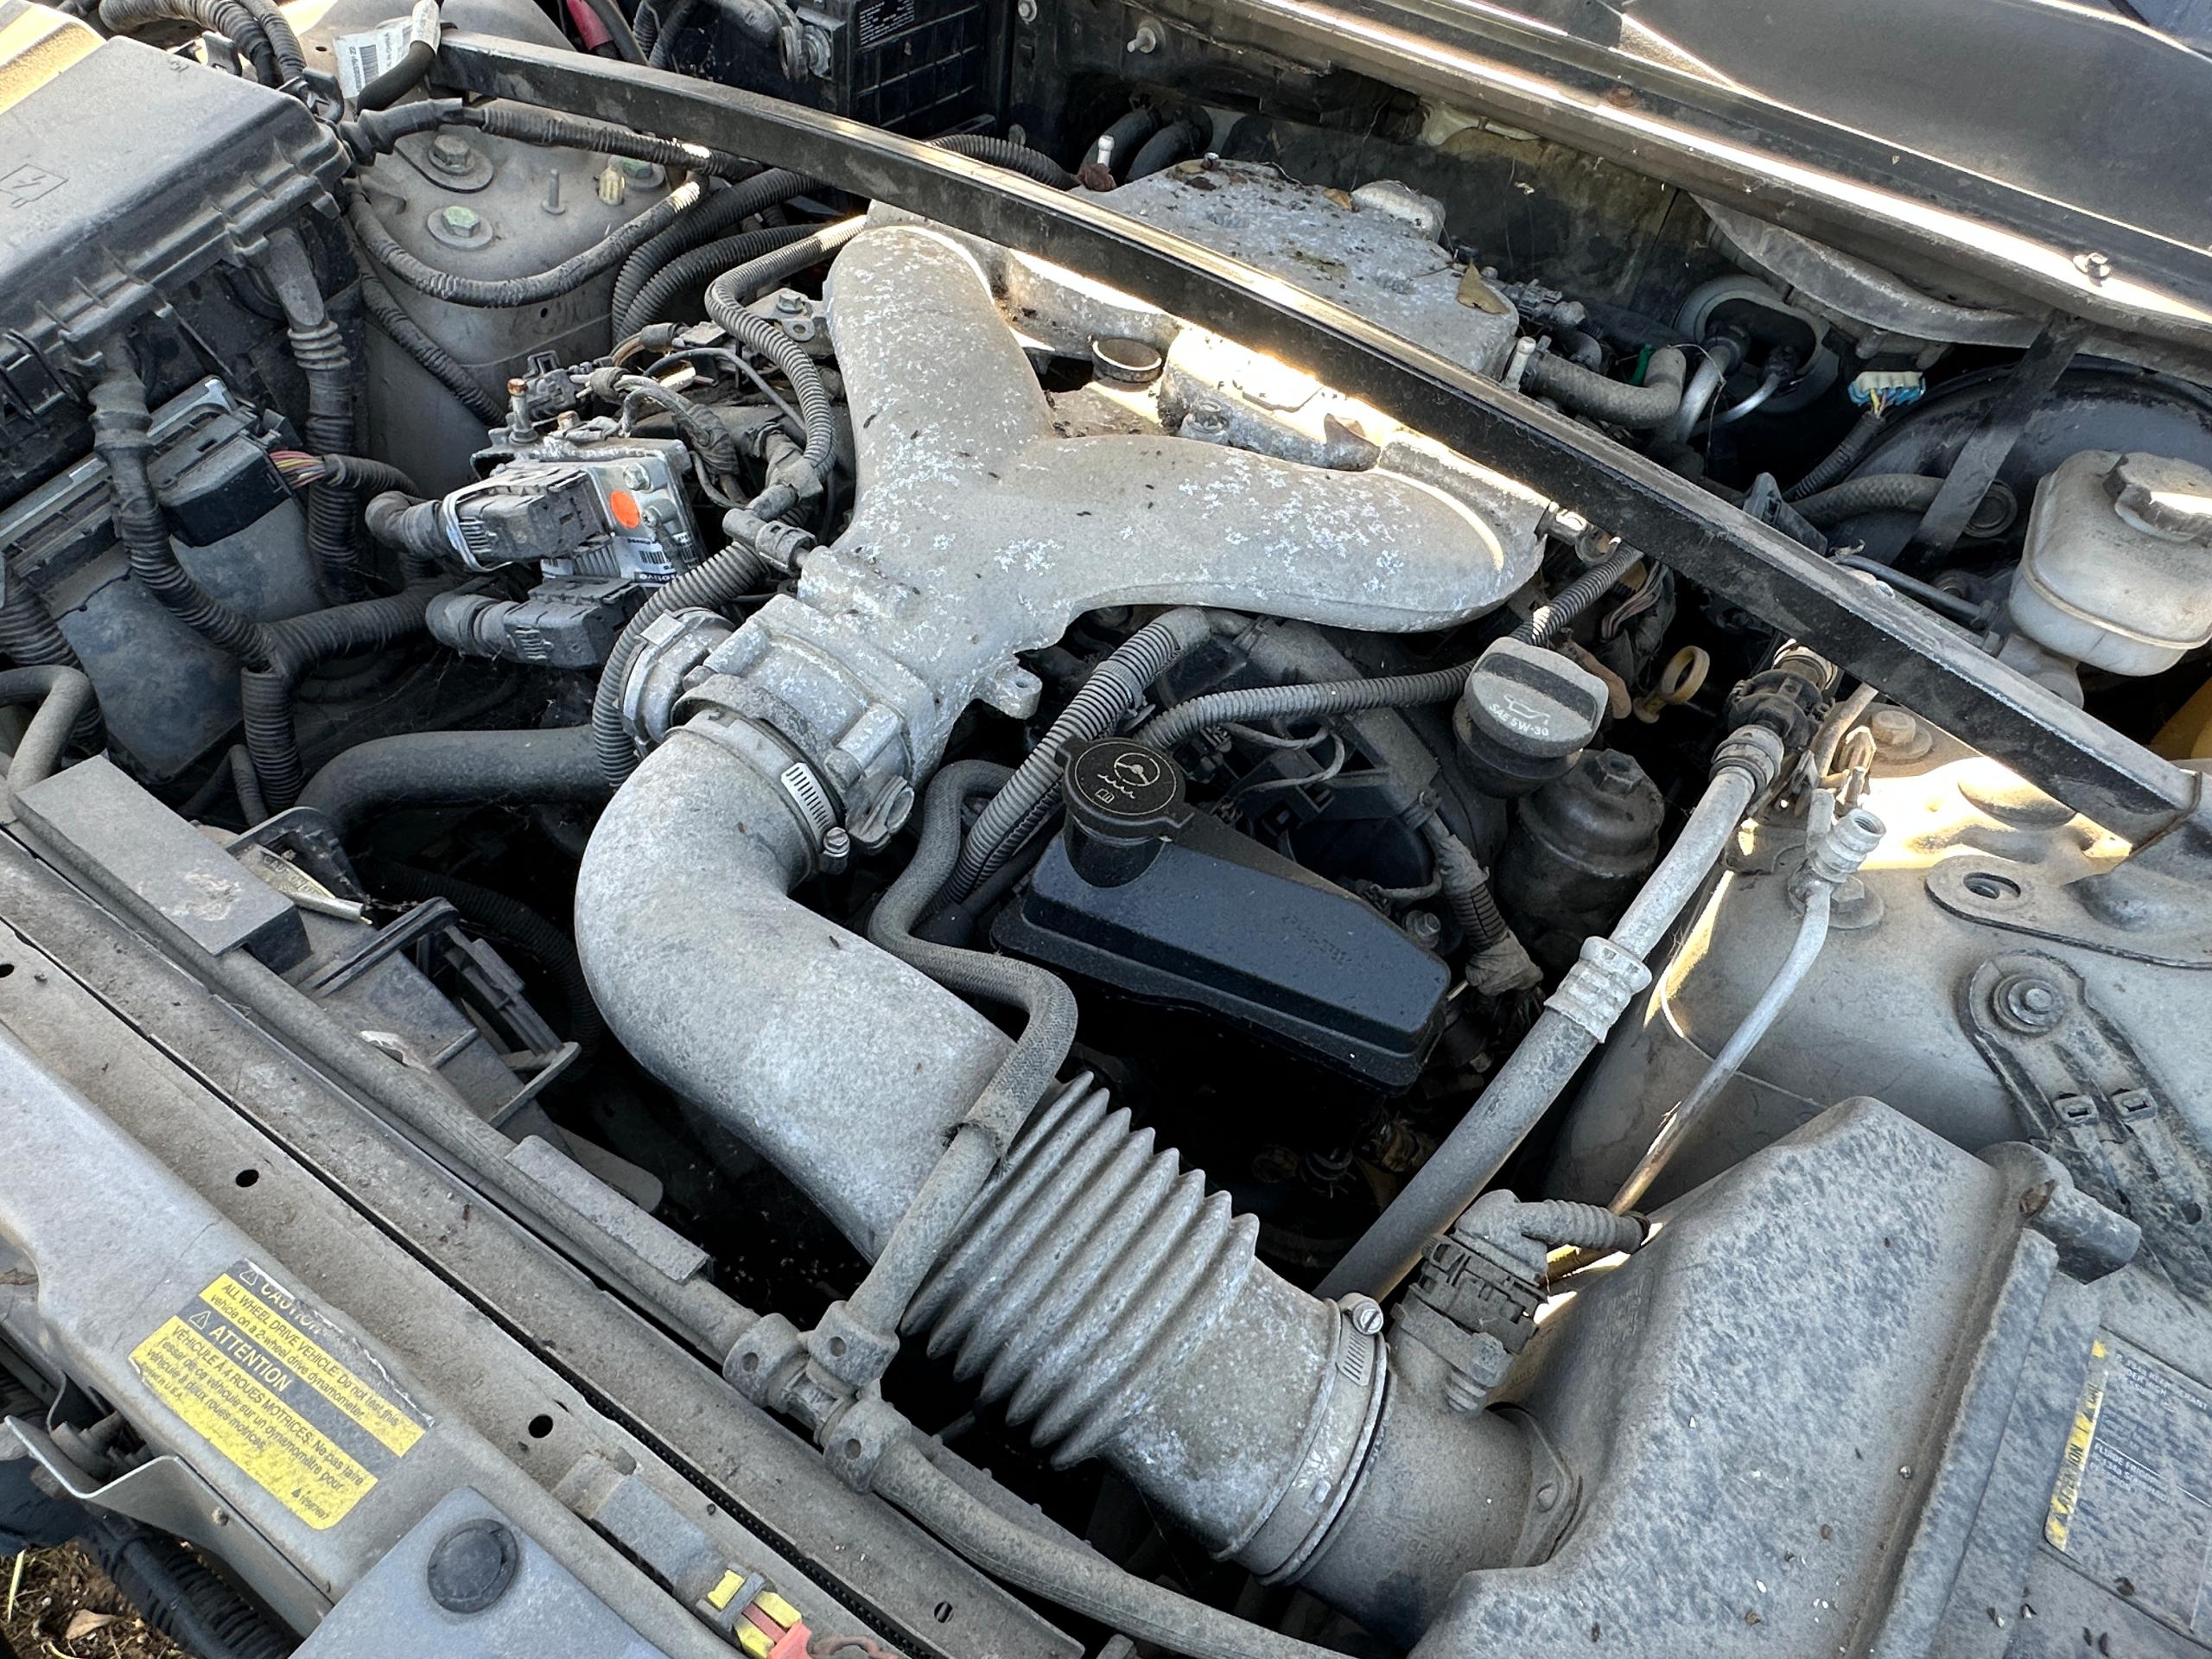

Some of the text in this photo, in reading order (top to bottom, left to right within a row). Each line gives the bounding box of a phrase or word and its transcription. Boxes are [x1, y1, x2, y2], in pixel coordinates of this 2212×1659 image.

[1489, 703, 1549, 736] SAE 5W-30
[170, 1324, 221, 1365] VÉHICULE
[209, 1294, 241, 1319] vehicle
[236, 1315, 251, 1328] on
[247, 1324, 257, 1333] a
[253, 1329, 291, 1359] 2-wheel
[285, 1354, 309, 1374] drive
[220, 1281, 242, 1300] ALL
[237, 1295, 273, 1324] WHEEL
[267, 1319, 302, 1346] DRIVE
[336, 1374, 353, 1389] Do
[349, 1384, 369, 1401] not
[364, 1395, 385, 1413] test
[379, 1408, 401, 1427] this
[207, 1323, 295, 1392] ATTENTION
[221, 1366, 234, 1377] 4
[183, 1379, 210, 1402] deux
[204, 1398, 231, 1421] roues
[227, 1372, 266, 1403] ROUES
[194, 1367, 208, 1379] ce
[205, 1375, 244, 1406] véhicule
[238, 1403, 256, 1418] sur
[252, 1414, 267, 1427] un
[318, 1471, 345, 1494] pour
[310, 1440, 329, 1454] Ne
[322, 1452, 345, 1470] pas
